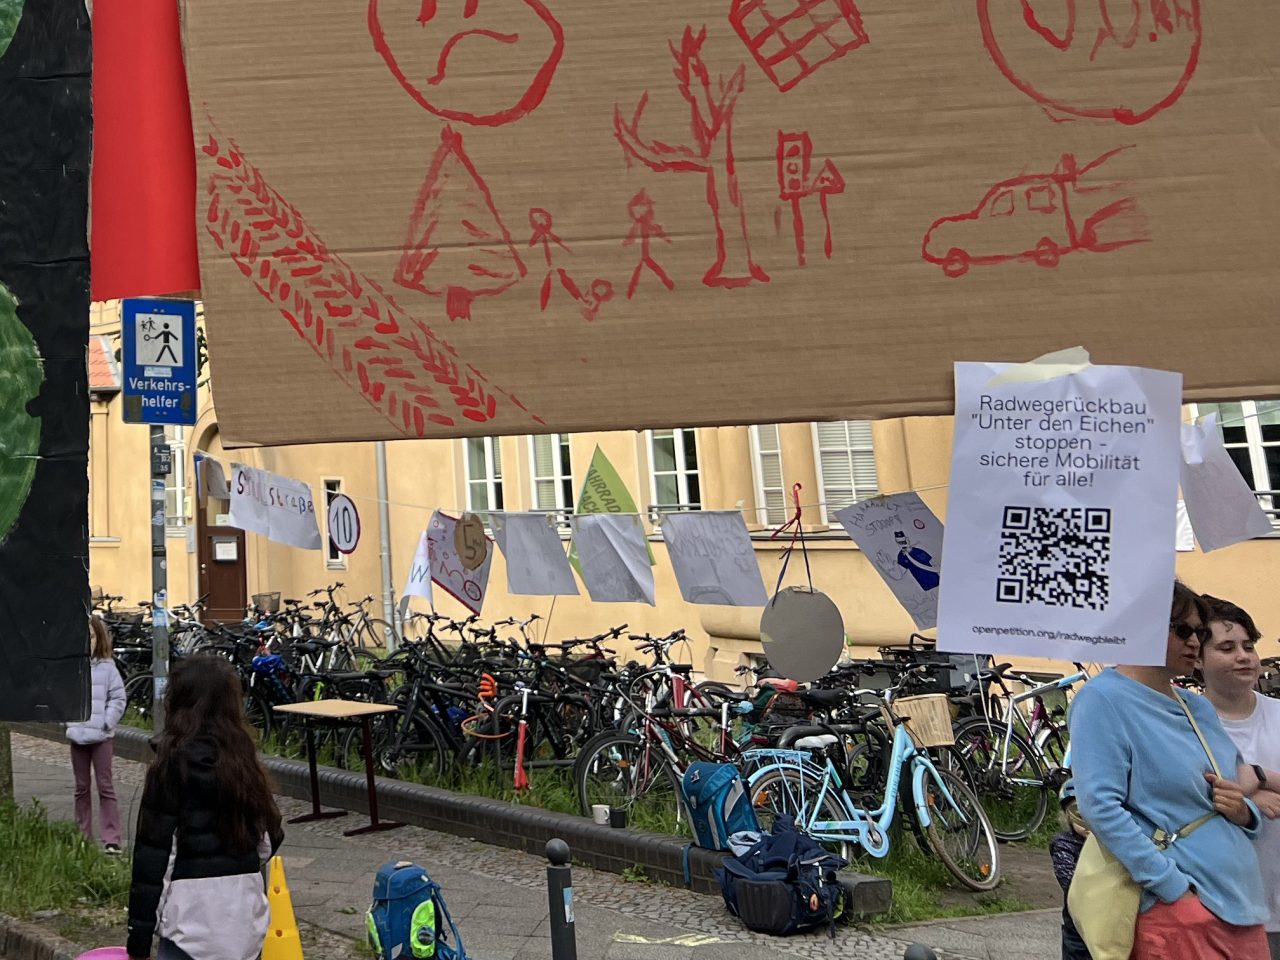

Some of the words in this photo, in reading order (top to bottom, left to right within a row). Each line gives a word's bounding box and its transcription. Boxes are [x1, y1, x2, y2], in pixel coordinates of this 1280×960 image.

[129, 377, 191, 391] Verkehrs-
[141, 394, 179, 408] helfer
[980, 395, 1147, 416] Radwegerückbau
[971, 413, 1032, 431] "Unter
[1039, 415, 1072, 431] den
[1080, 416, 1155, 434] Eichen"
[1015, 436, 1092, 453] stoppen
[979, 451, 1049, 468] sichere
[1055, 453, 1141, 471] Mobilität
[1023, 471, 1050, 487] für
[1055, 471, 1094, 488] alle!
[332, 505, 353, 545] 10
[971, 625, 1127, 646] openpetition.org/radwegbleibt
